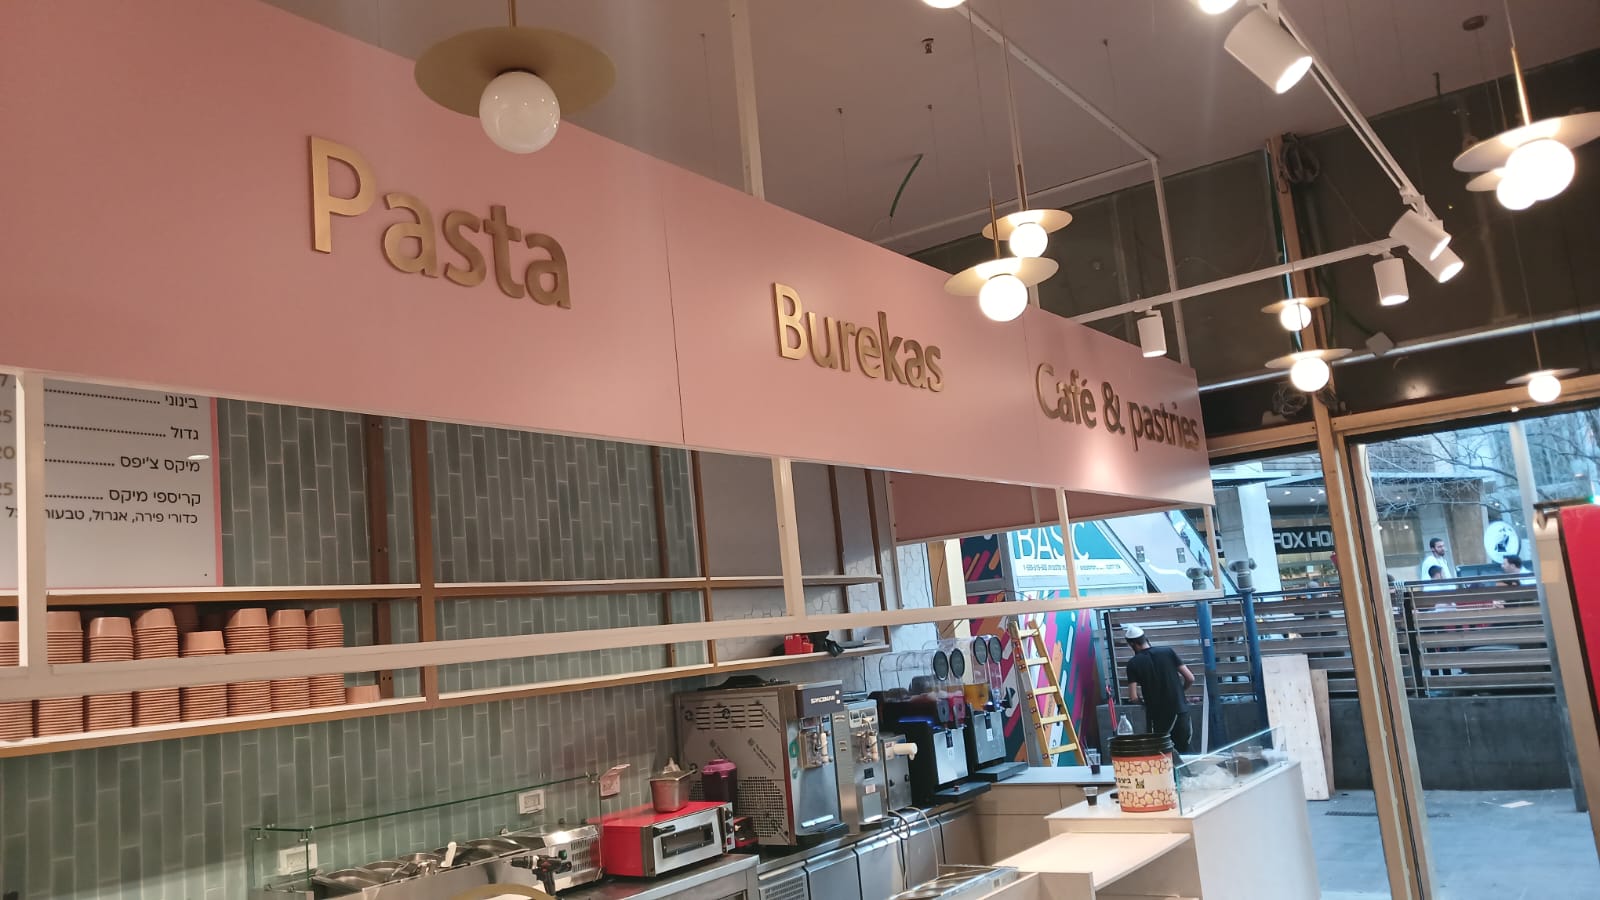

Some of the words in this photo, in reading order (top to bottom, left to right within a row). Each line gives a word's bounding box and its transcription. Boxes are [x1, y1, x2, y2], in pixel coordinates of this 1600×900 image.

[307, 135, 571, 309] Pasta
[771, 282, 944, 393] Burekas
[165, 395, 198, 409] בינוני
[1035, 362, 1097, 429] Café
[1101, 381, 1126, 435] &
[1127, 401, 1200, 452] pastries
[0, 409, 13, 424] 5
[170, 426, 199, 440] גדול
[0, 446, 16, 460] 0
[120, 456, 159, 470] צ'יפס
[164, 459, 200, 473] מיקס
[0, 482, 13, 496] 5
[109, 489, 148, 504] מיקס
[153, 492, 201, 507] קריספי
[131, 512, 164, 523] פירה,
[168, 513, 198, 524] כדורי
[1307, 530, 1335, 548] HO
